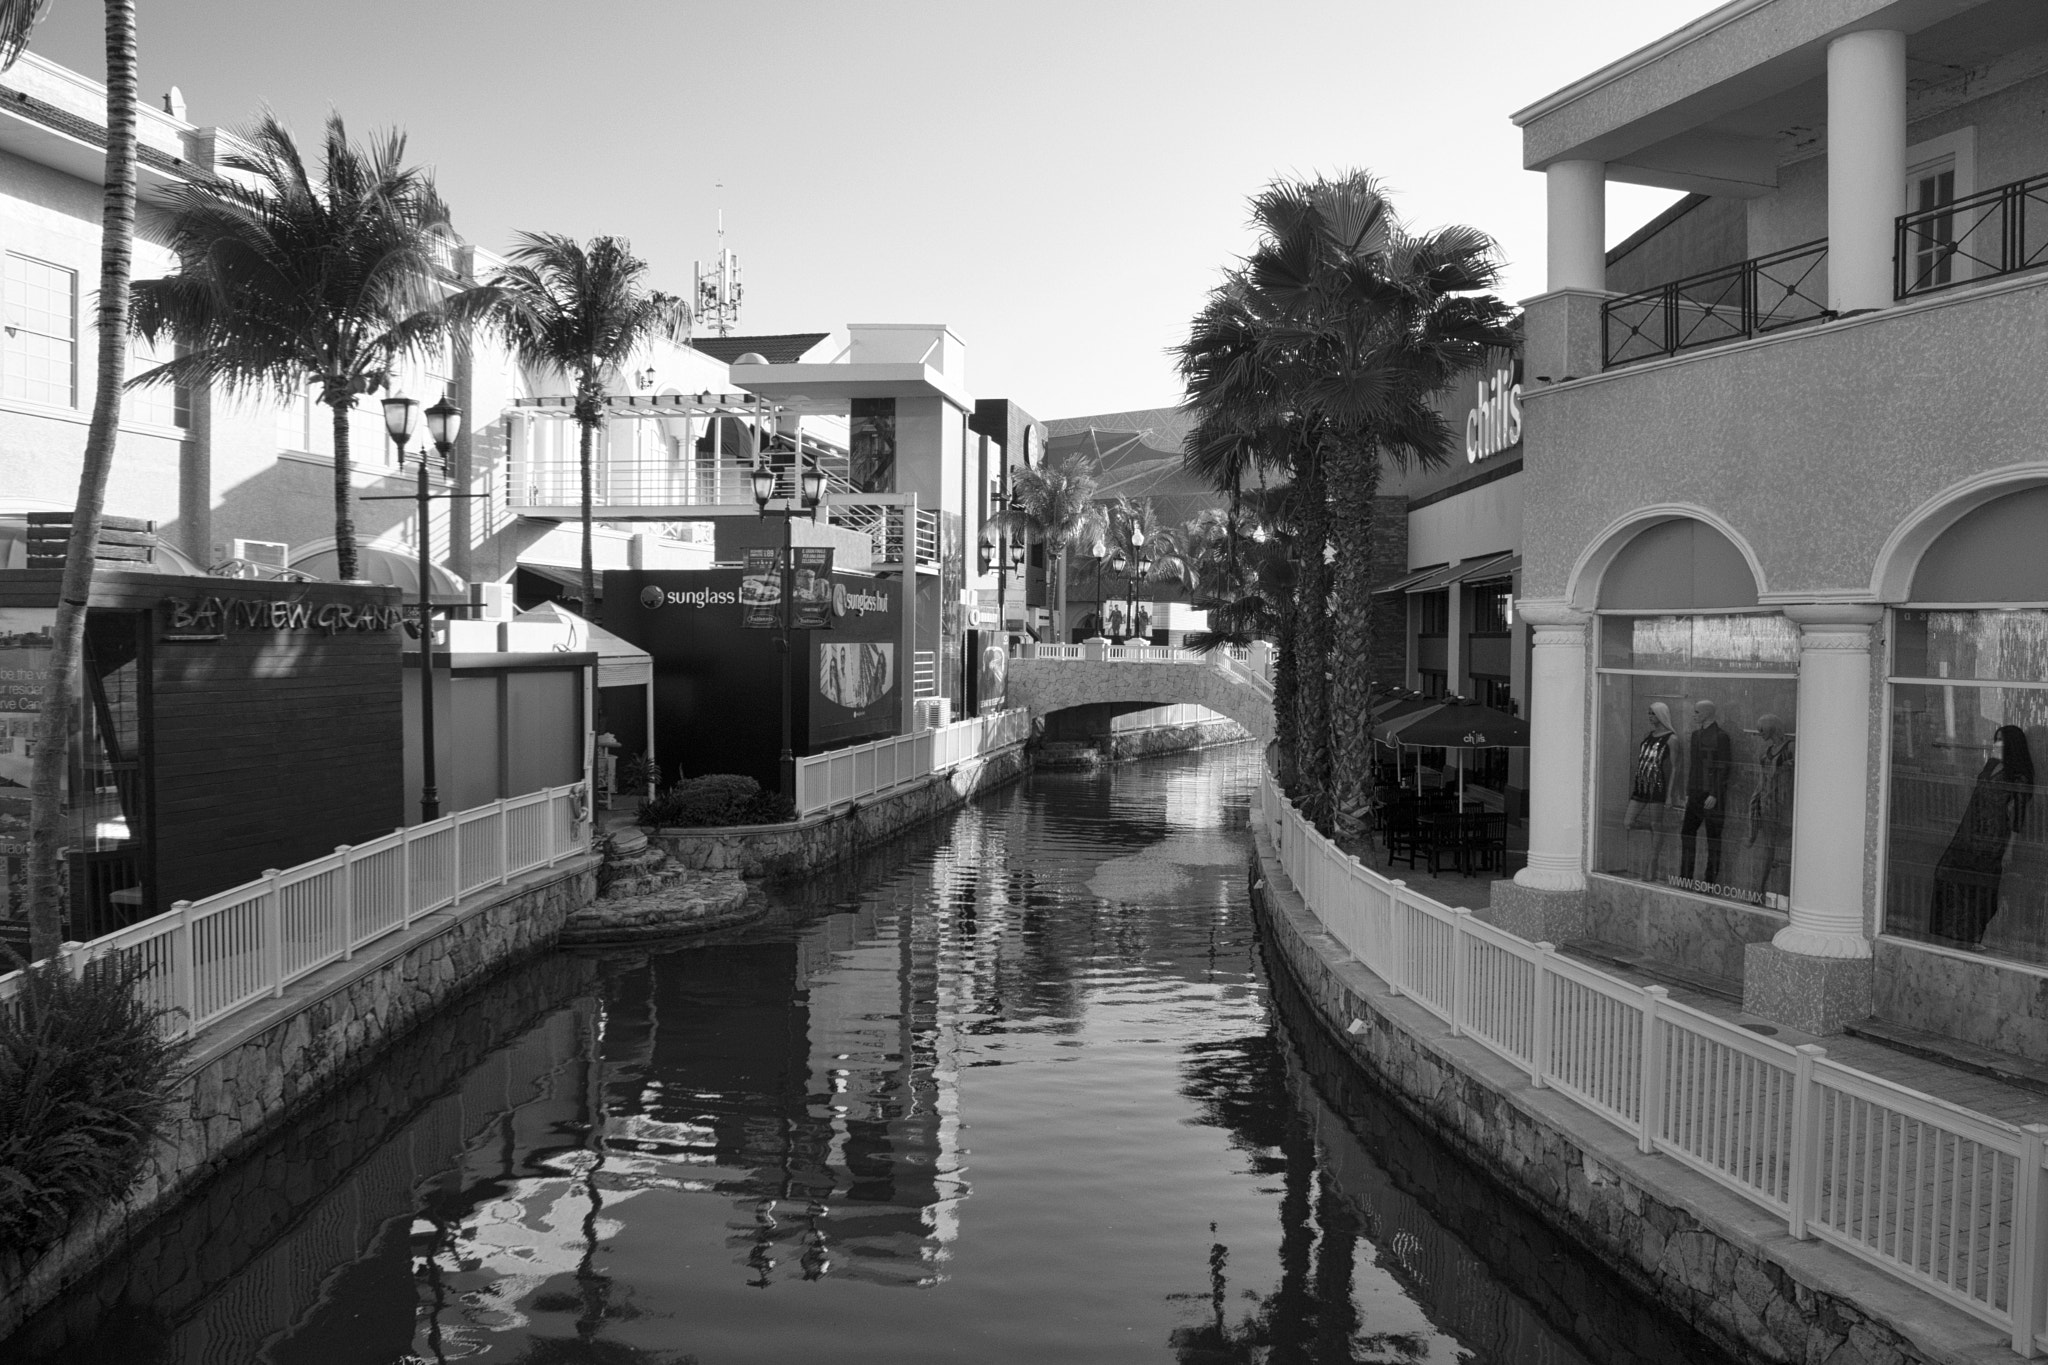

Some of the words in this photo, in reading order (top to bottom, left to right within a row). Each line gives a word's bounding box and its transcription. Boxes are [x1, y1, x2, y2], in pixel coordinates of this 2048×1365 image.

[1466, 360, 1523, 464] chili's
[667, 587, 735, 609] sunglass
[846, 589, 877, 617] sunglass
[877, 590, 889, 613] hut
[171, 597, 235, 629] BAY
[240, 600, 312, 630] VIEW
[0, 667, 14, 680] be
[17, 667, 34, 680] the
[0, 699, 17, 710] rve
[0, 843, 28, 854] traor
[1667, 874, 1764, 904] WWW.SOHO.COM.MX
